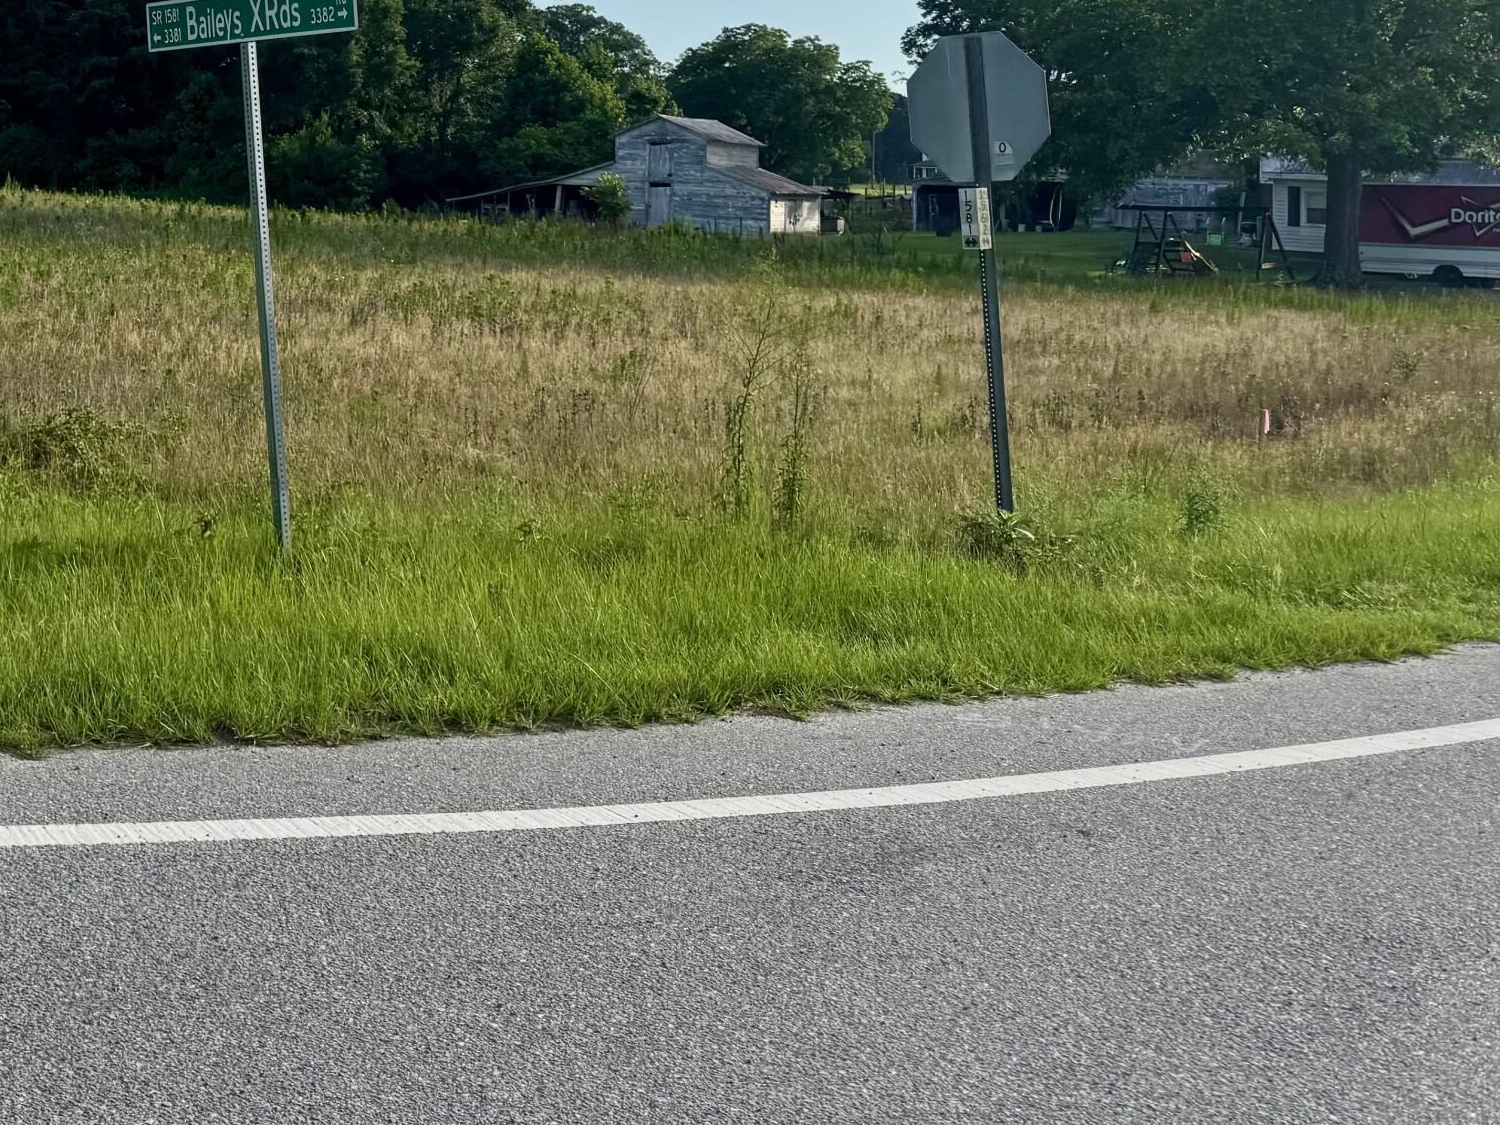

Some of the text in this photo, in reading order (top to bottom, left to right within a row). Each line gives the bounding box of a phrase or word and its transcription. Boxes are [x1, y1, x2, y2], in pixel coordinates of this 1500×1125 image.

[151, 8, 180, 25] SR 1581
[185, 5, 242, 41] Baileys
[310, 6, 335, 24] 3382
[164, 27, 182, 44] 3381
[964, 189, 973, 235] 1581
